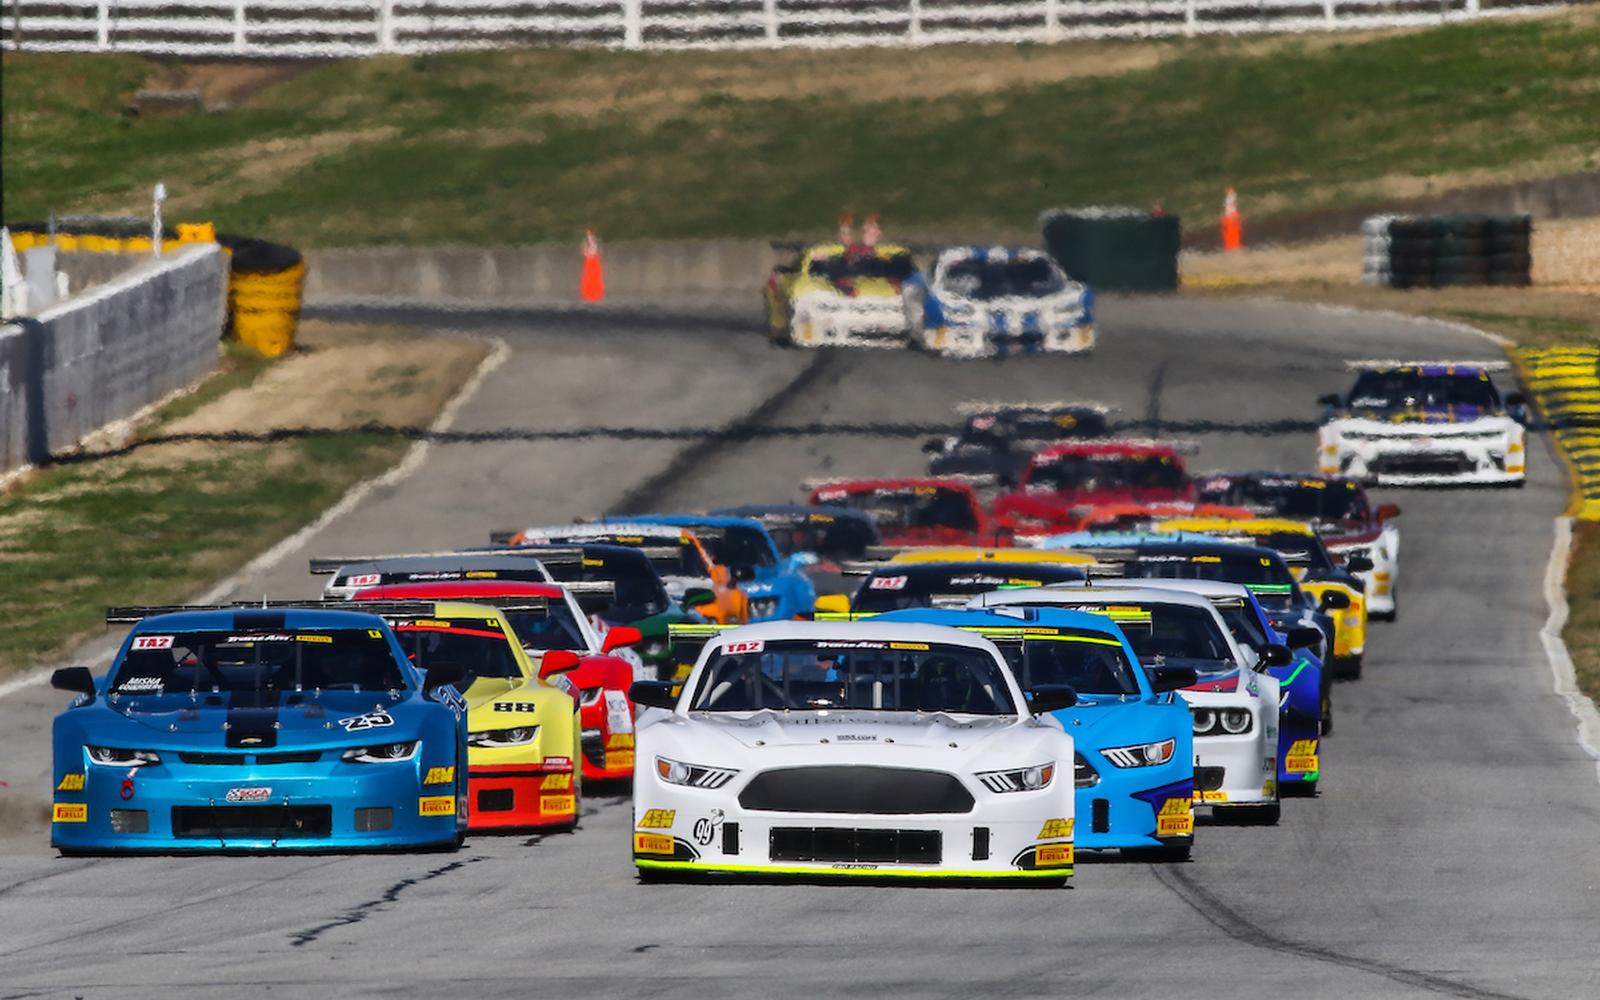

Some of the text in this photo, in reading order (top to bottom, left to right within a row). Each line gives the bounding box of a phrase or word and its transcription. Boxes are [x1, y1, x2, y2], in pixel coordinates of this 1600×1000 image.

[138, 637, 170, 648] TA2
[728, 641, 761, 653] TA2
[494, 702, 535, 713] 88
[423, 766, 455, 785] AEM
[57, 806, 84, 818] PIRELLI
[422, 799, 452, 812] PIRELLI
[543, 799, 571, 811] PIRELLI
[1159, 797, 1192, 815] AEM
[637, 808, 677, 829] AEM
[1161, 817, 1189, 831] PIRELLI
[693, 817, 715, 847] 99
[1036, 817, 1075, 840] AEM
[639, 836, 671, 850] PIRELLI
[1039, 847, 1070, 861] PIRELLI
